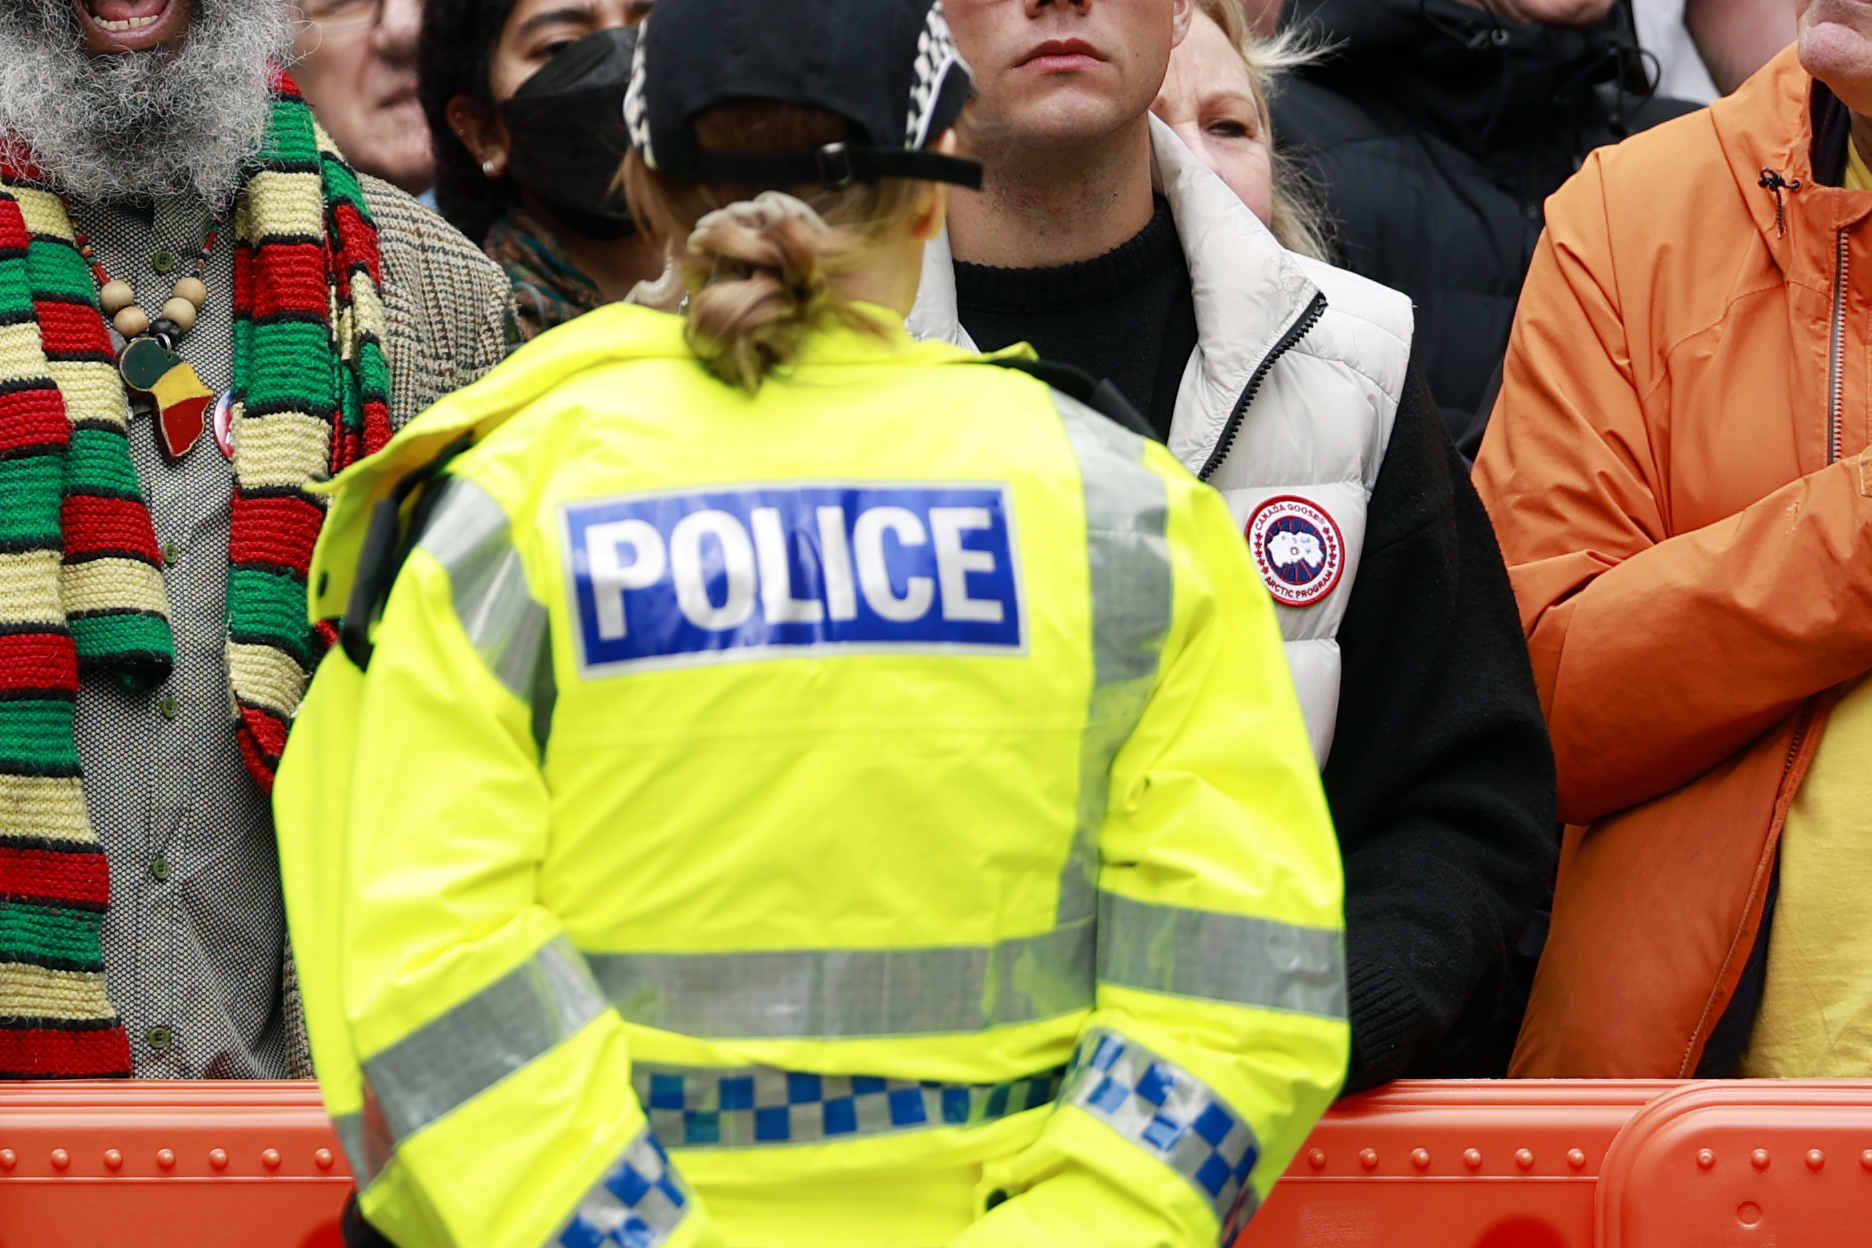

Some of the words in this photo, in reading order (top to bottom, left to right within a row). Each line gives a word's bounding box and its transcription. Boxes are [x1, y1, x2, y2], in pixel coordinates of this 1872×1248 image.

[1255, 503, 1286, 531] CANADA
[585, 505, 1005, 641] POLICE
[1264, 575, 1294, 598] ARCTIC
[1295, 570, 1334, 599] PROGRAM
